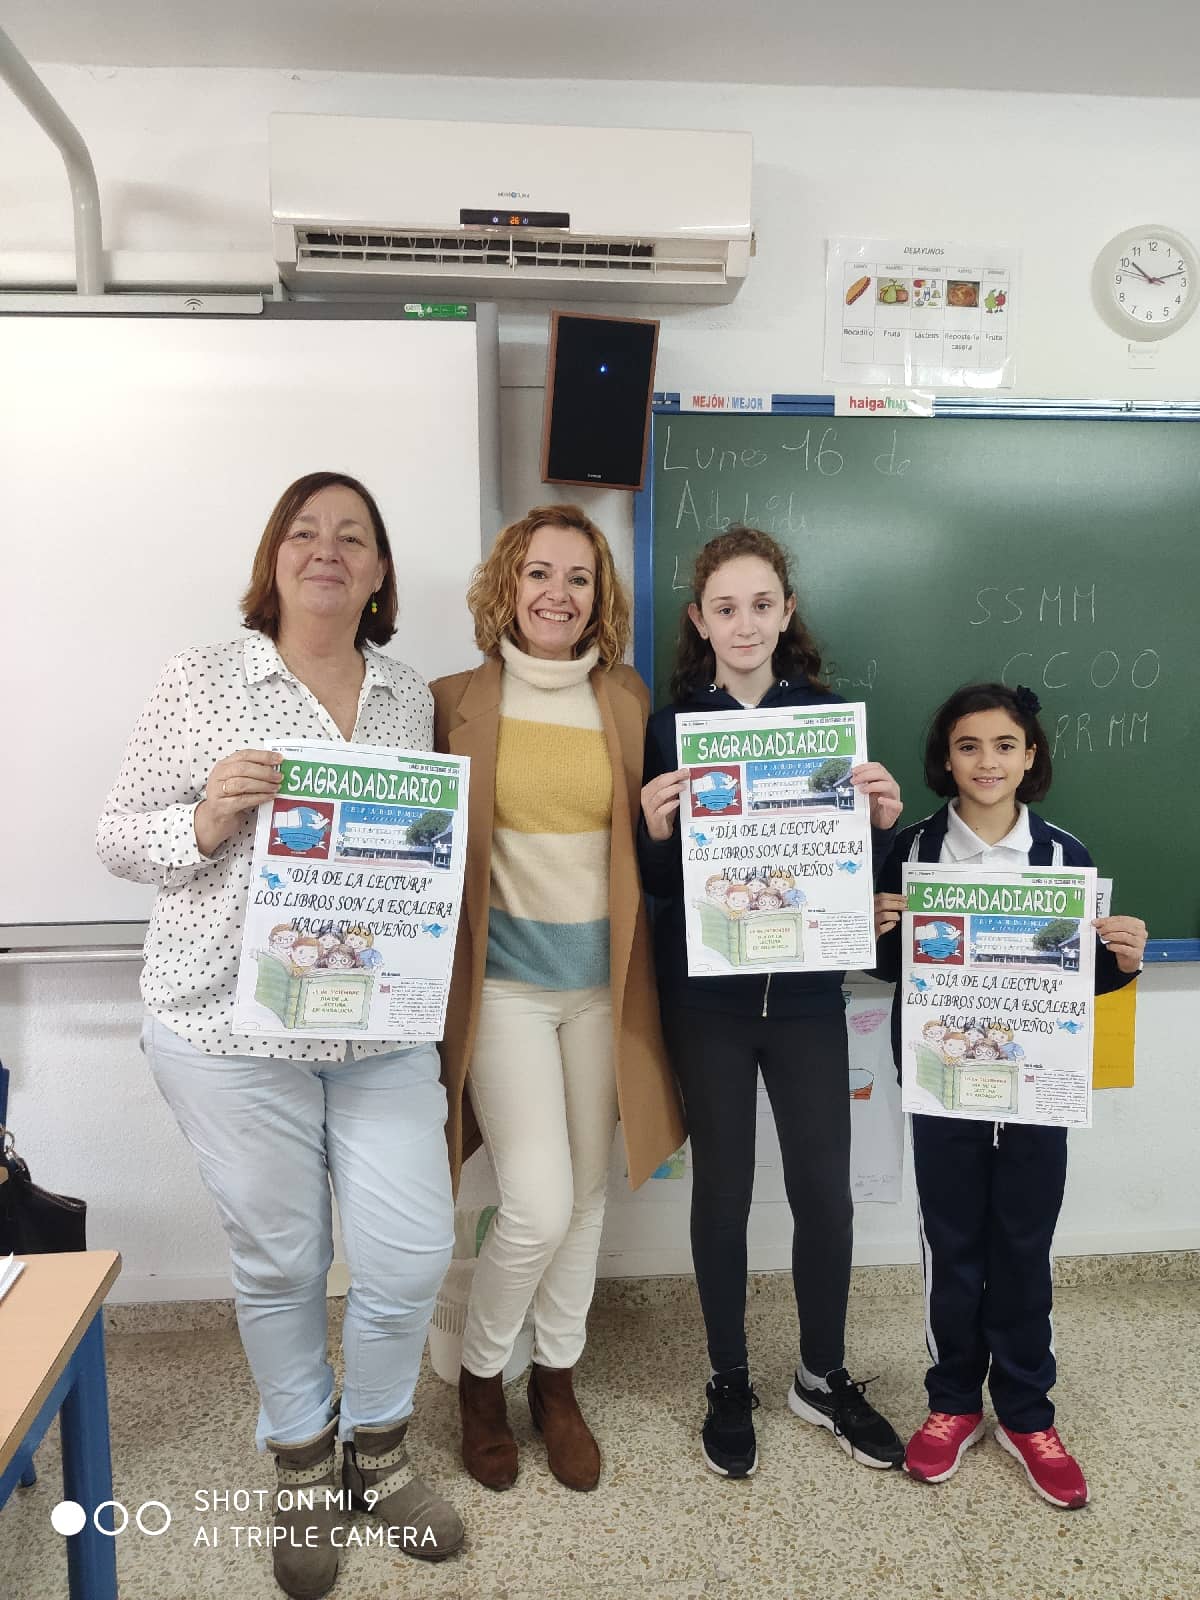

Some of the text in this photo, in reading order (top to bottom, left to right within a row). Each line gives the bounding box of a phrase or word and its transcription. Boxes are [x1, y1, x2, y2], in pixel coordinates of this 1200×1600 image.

[904, 247, 945, 256] DESAYUNOS
[1132, 247, 1141, 256] 11
[1149, 241, 1158, 251] 12
[1167, 248, 1171, 257] 1
[1120, 257, 1130, 267] 10
[1178, 260, 1184, 270] 2
[1115, 275, 1122, 284] 9
[1181, 278, 1187, 287] 3
[1119, 293, 1125, 302] 8
[1175, 296, 1181, 304] 4
[1132, 306, 1137, 314] 7
[1146, 311, 1152, 320] 6
[1163, 307, 1169, 316] 5
[782, 427, 844, 477] 16
[697, 729, 839, 761] SAGRADADIARIO
[288, 766, 442, 804] SAGRADADIARIO
[740, 825, 759, 837] DE
[761, 823, 777, 837] LA
[688, 840, 864, 861] LOS LIBROS SON LA ESCALERA
[721, 860, 833, 881] HACIA TUS SUEÑOS
[322, 871, 343, 884] DE
[345, 873, 364, 888] LA
[254, 890, 453, 918] LOS LIBROS SON LA ESCALERA
[923, 885, 1067, 914] SAGRADADIARIO
[291, 917, 419, 939] HACIA TUS SUEÑOS
[961, 975, 979, 988] DE
[983, 976, 998, 990] LA
[907, 993, 1086, 1016] LOS LIBROS SON LA ESCALERA
[939, 1014, 1054, 1034] HACIA TUS SUEÑOS
